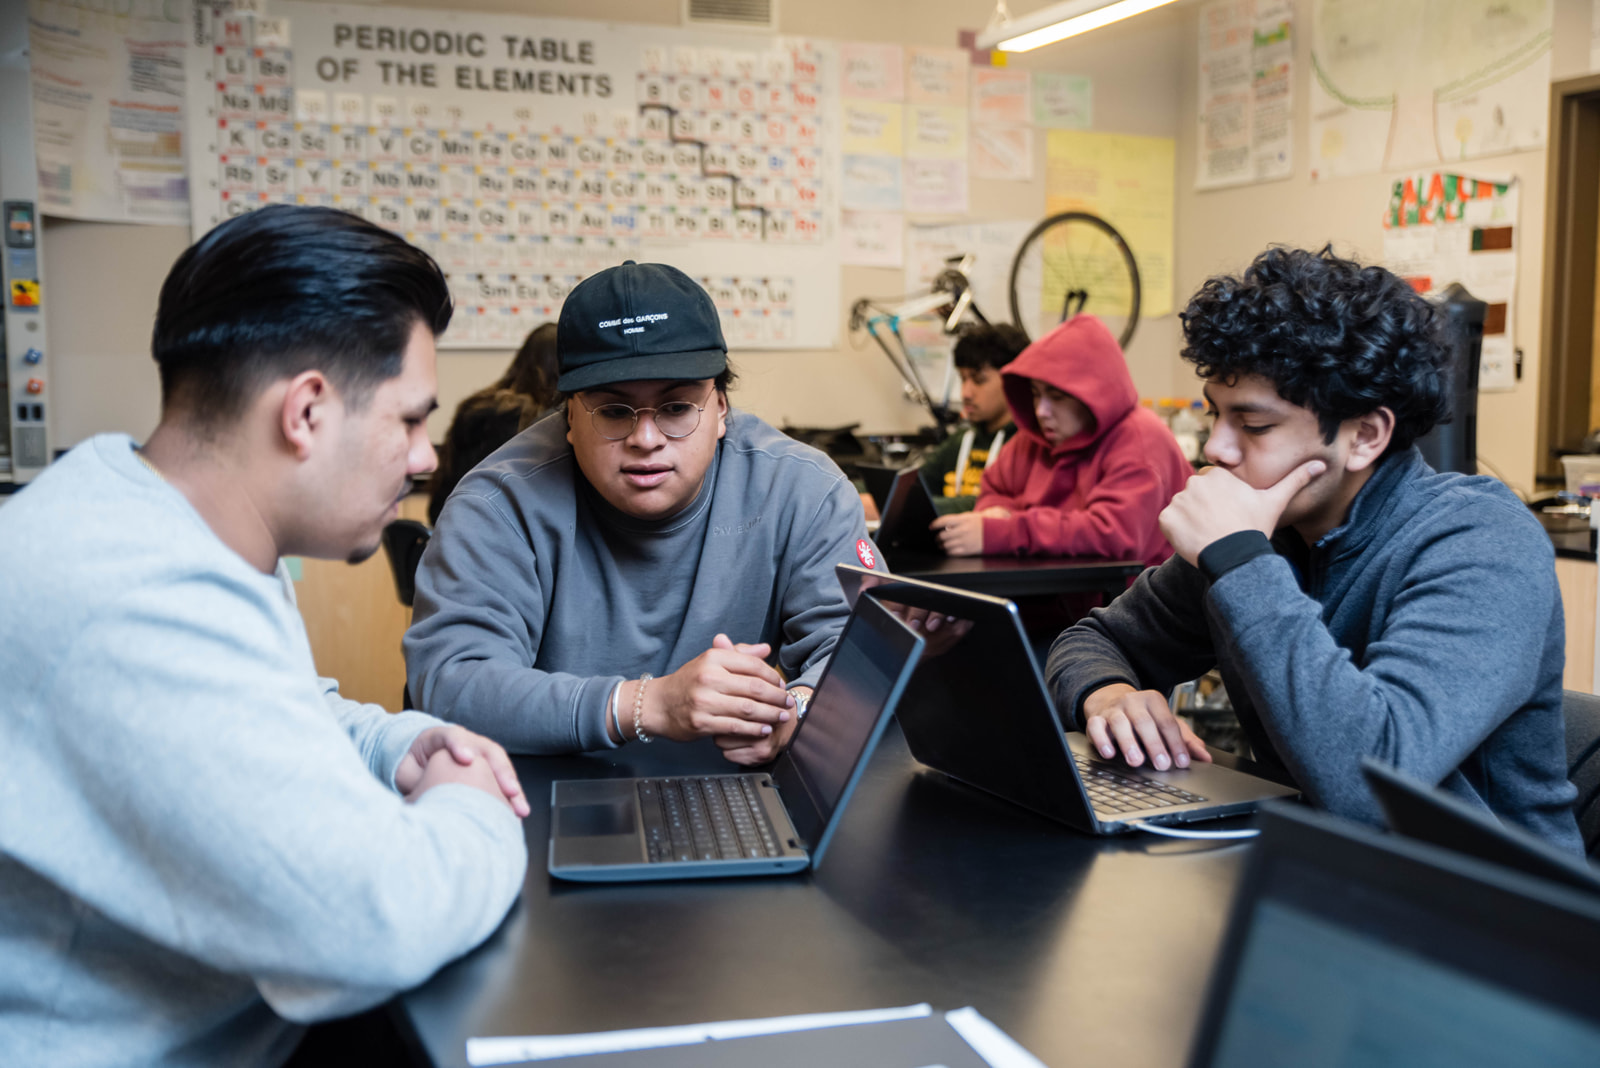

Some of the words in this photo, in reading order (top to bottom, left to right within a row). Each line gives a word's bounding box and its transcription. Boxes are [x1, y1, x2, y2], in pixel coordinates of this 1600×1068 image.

[334, 23, 486, 58] PERIODIC
[503, 36, 595, 65] TABLE
[259, 59, 286, 75] Be
[316, 57, 359, 82] OF
[376, 61, 438, 88] THE
[456, 66, 613, 98] ELEMENTS
[223, 97, 250, 109] Na
[231, 131, 244, 145] K
[262, 132, 290, 148] Ca
[301, 134, 324, 149] Sc
[343, 136, 358, 149] Ti
[380, 138, 393, 151] V
[410, 138, 433, 154] Cr
[511, 143, 537, 159] Co
[578, 146, 604, 162] Cu
[266, 169, 288, 183] Sr
[308, 171, 322, 182] Y
[373, 173, 399, 186] Nb
[407, 175, 435, 187] Mo
[381, 208, 398, 221] Ta
[414, 208, 432, 221] W
[480, 285, 509, 298] Sm
[516, 285, 538, 299] Eu
[598, 318, 621, 328] COMME
[635, 313, 668, 324] GARÇONS
[623, 326, 645, 335] HOMME
